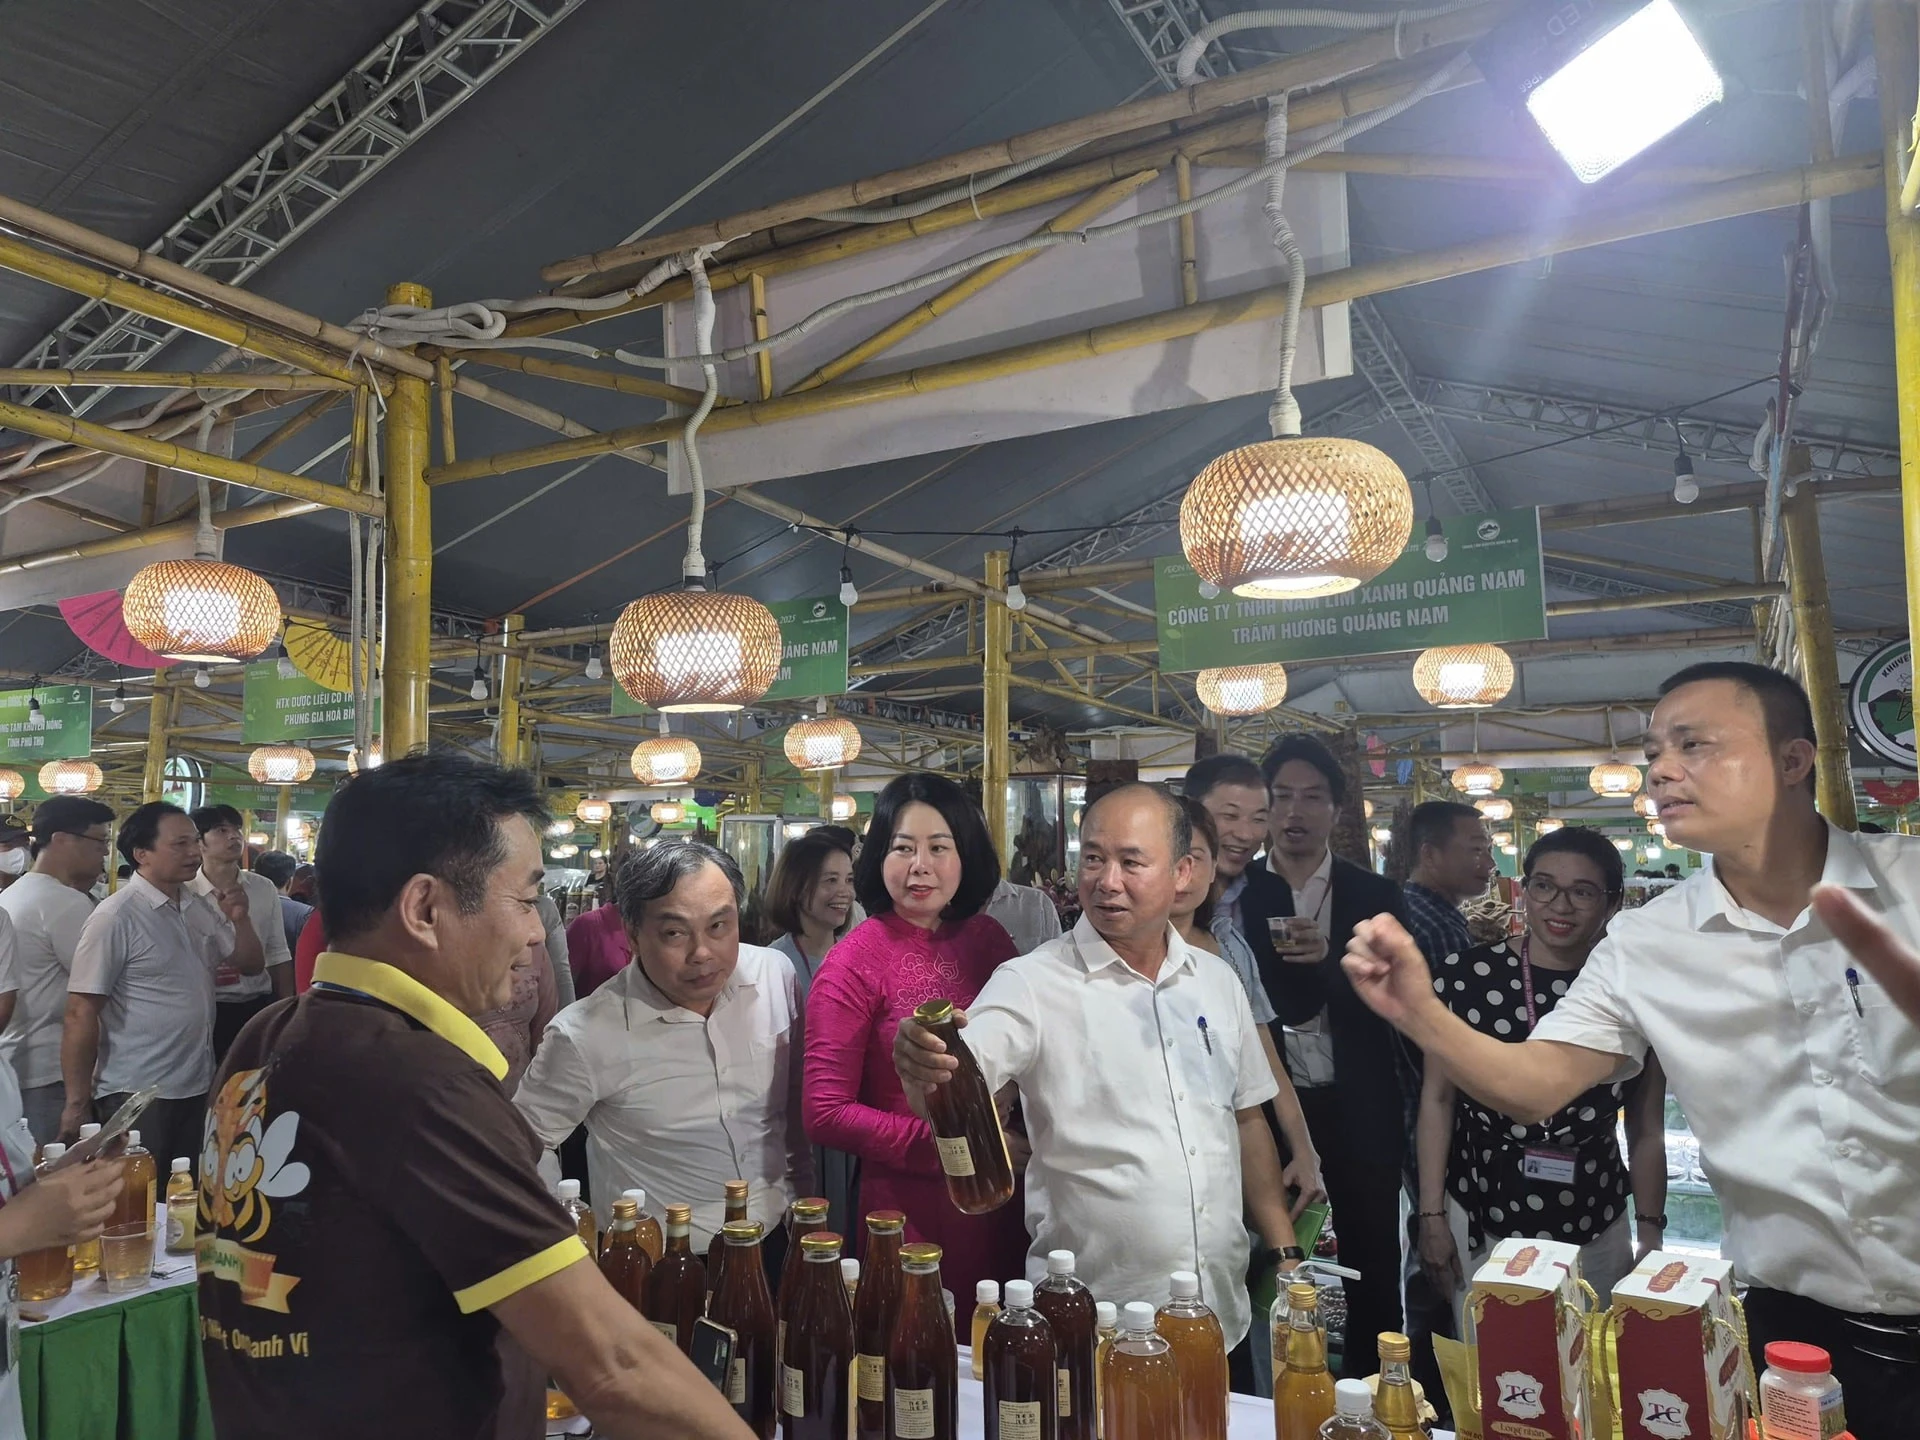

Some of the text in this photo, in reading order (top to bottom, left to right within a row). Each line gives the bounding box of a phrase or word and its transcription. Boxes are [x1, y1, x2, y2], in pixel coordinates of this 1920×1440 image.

[1168, 605, 1209, 626] CÔNG
[1213, 603, 1231, 620] TY
[1236, 600, 1277, 618] TNHH
[1361, 582, 1408, 604] XANH
[1413, 572, 1475, 600] QUẢNG
[1481, 568, 1526, 591] NAM
[1281, 617, 1337, 639] HƯƠNG
[1342, 607, 1401, 634] QUẢNG
[1407, 605, 1449, 626] NAM
[811, 639, 838, 656] NAM
[276, 697, 290, 709] HTX
[311, 710, 324, 724] GIA
